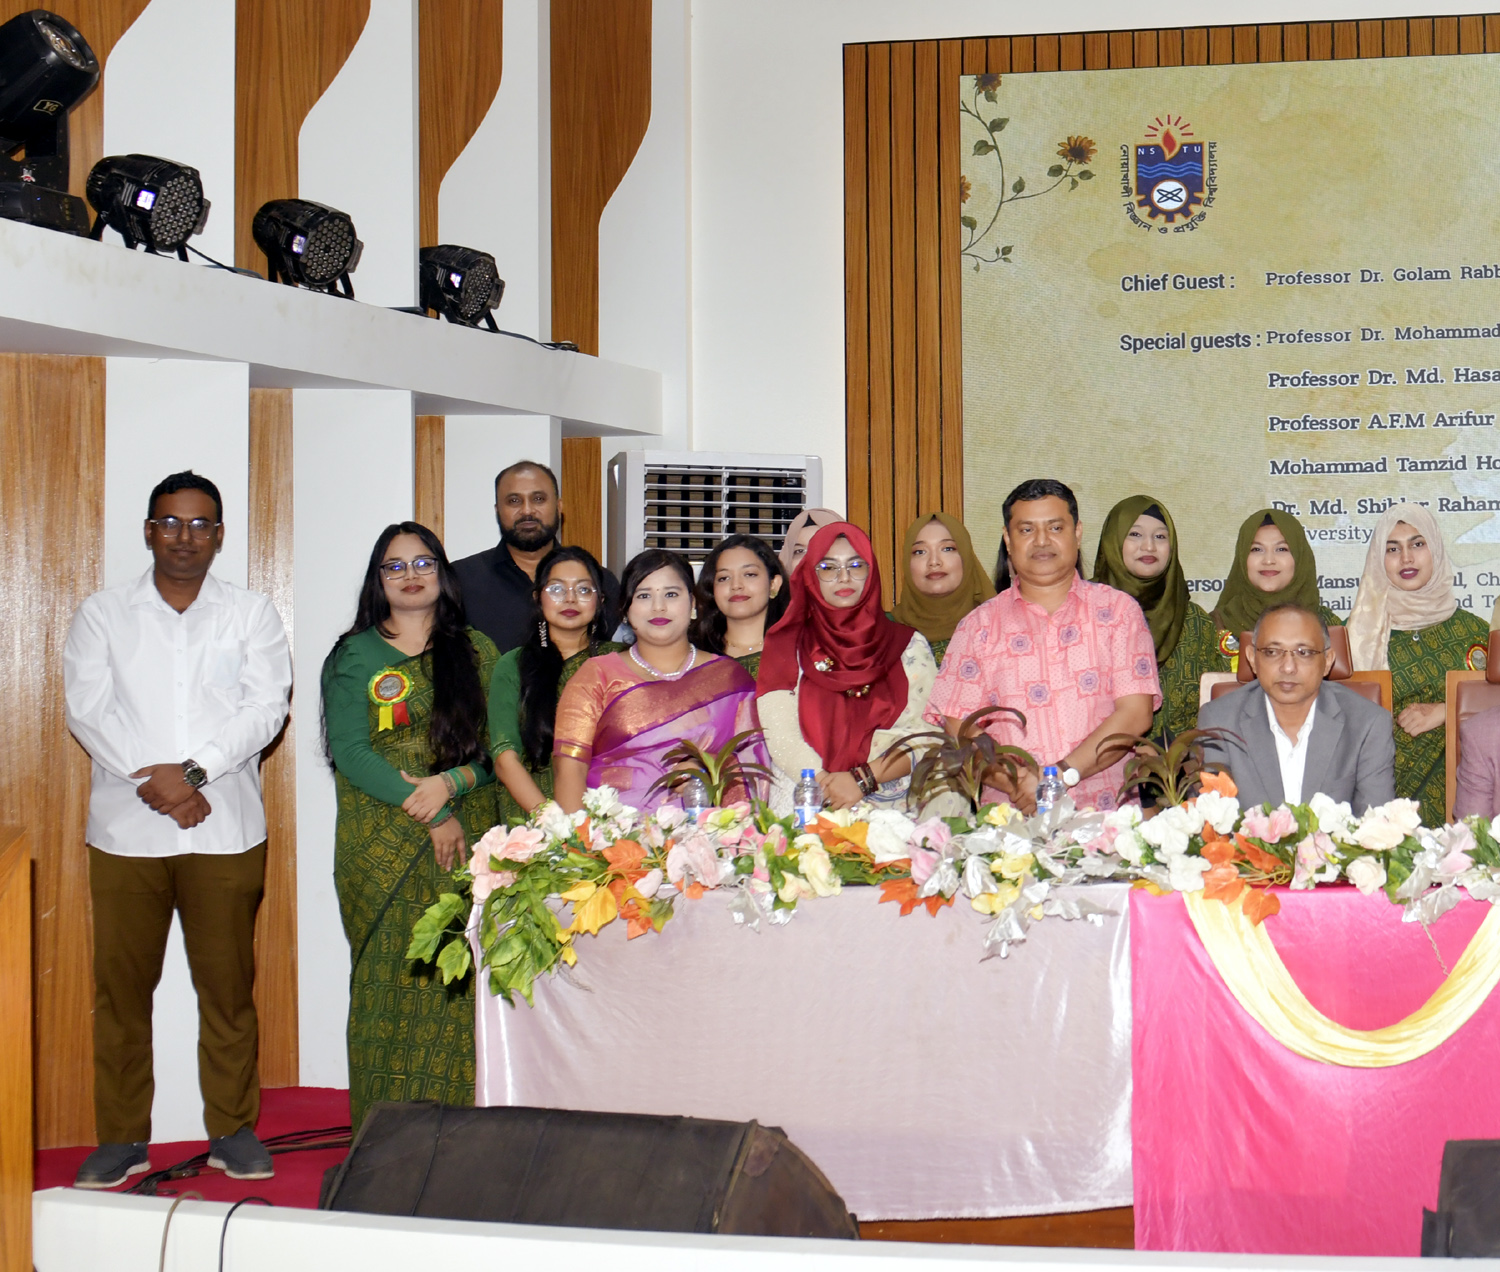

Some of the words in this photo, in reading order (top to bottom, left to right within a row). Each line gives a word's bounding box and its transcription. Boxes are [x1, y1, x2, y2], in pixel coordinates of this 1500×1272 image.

[1121, 273, 1169, 292] Chief
[1172, 273, 1226, 290] Guest
[1265, 270, 1352, 286] Professor
[1359, 269, 1384, 283] Dr.
[1393, 266, 1452, 282] Golam
[1120, 332, 1186, 355] Special
[1190, 332, 1252, 353] guests
[1266, 328, 1352, 344] Professor
[1360, 327, 1385, 342] Dr.
[1268, 370, 1360, 388] Professor
[1368, 369, 1397, 385] Dr.
[1405, 367, 1445, 384] Md.
[1268, 414, 1360, 432] Professor
[1367, 413, 1425, 430] A.F.M
[1432, 410, 1495, 428] Arifur
[1269, 456, 1388, 475] Mohammad
[1395, 454, 1468, 472] Tamzid
[1309, 498, 1348, 515] Md.
[1302, 525, 1373, 544] versity
